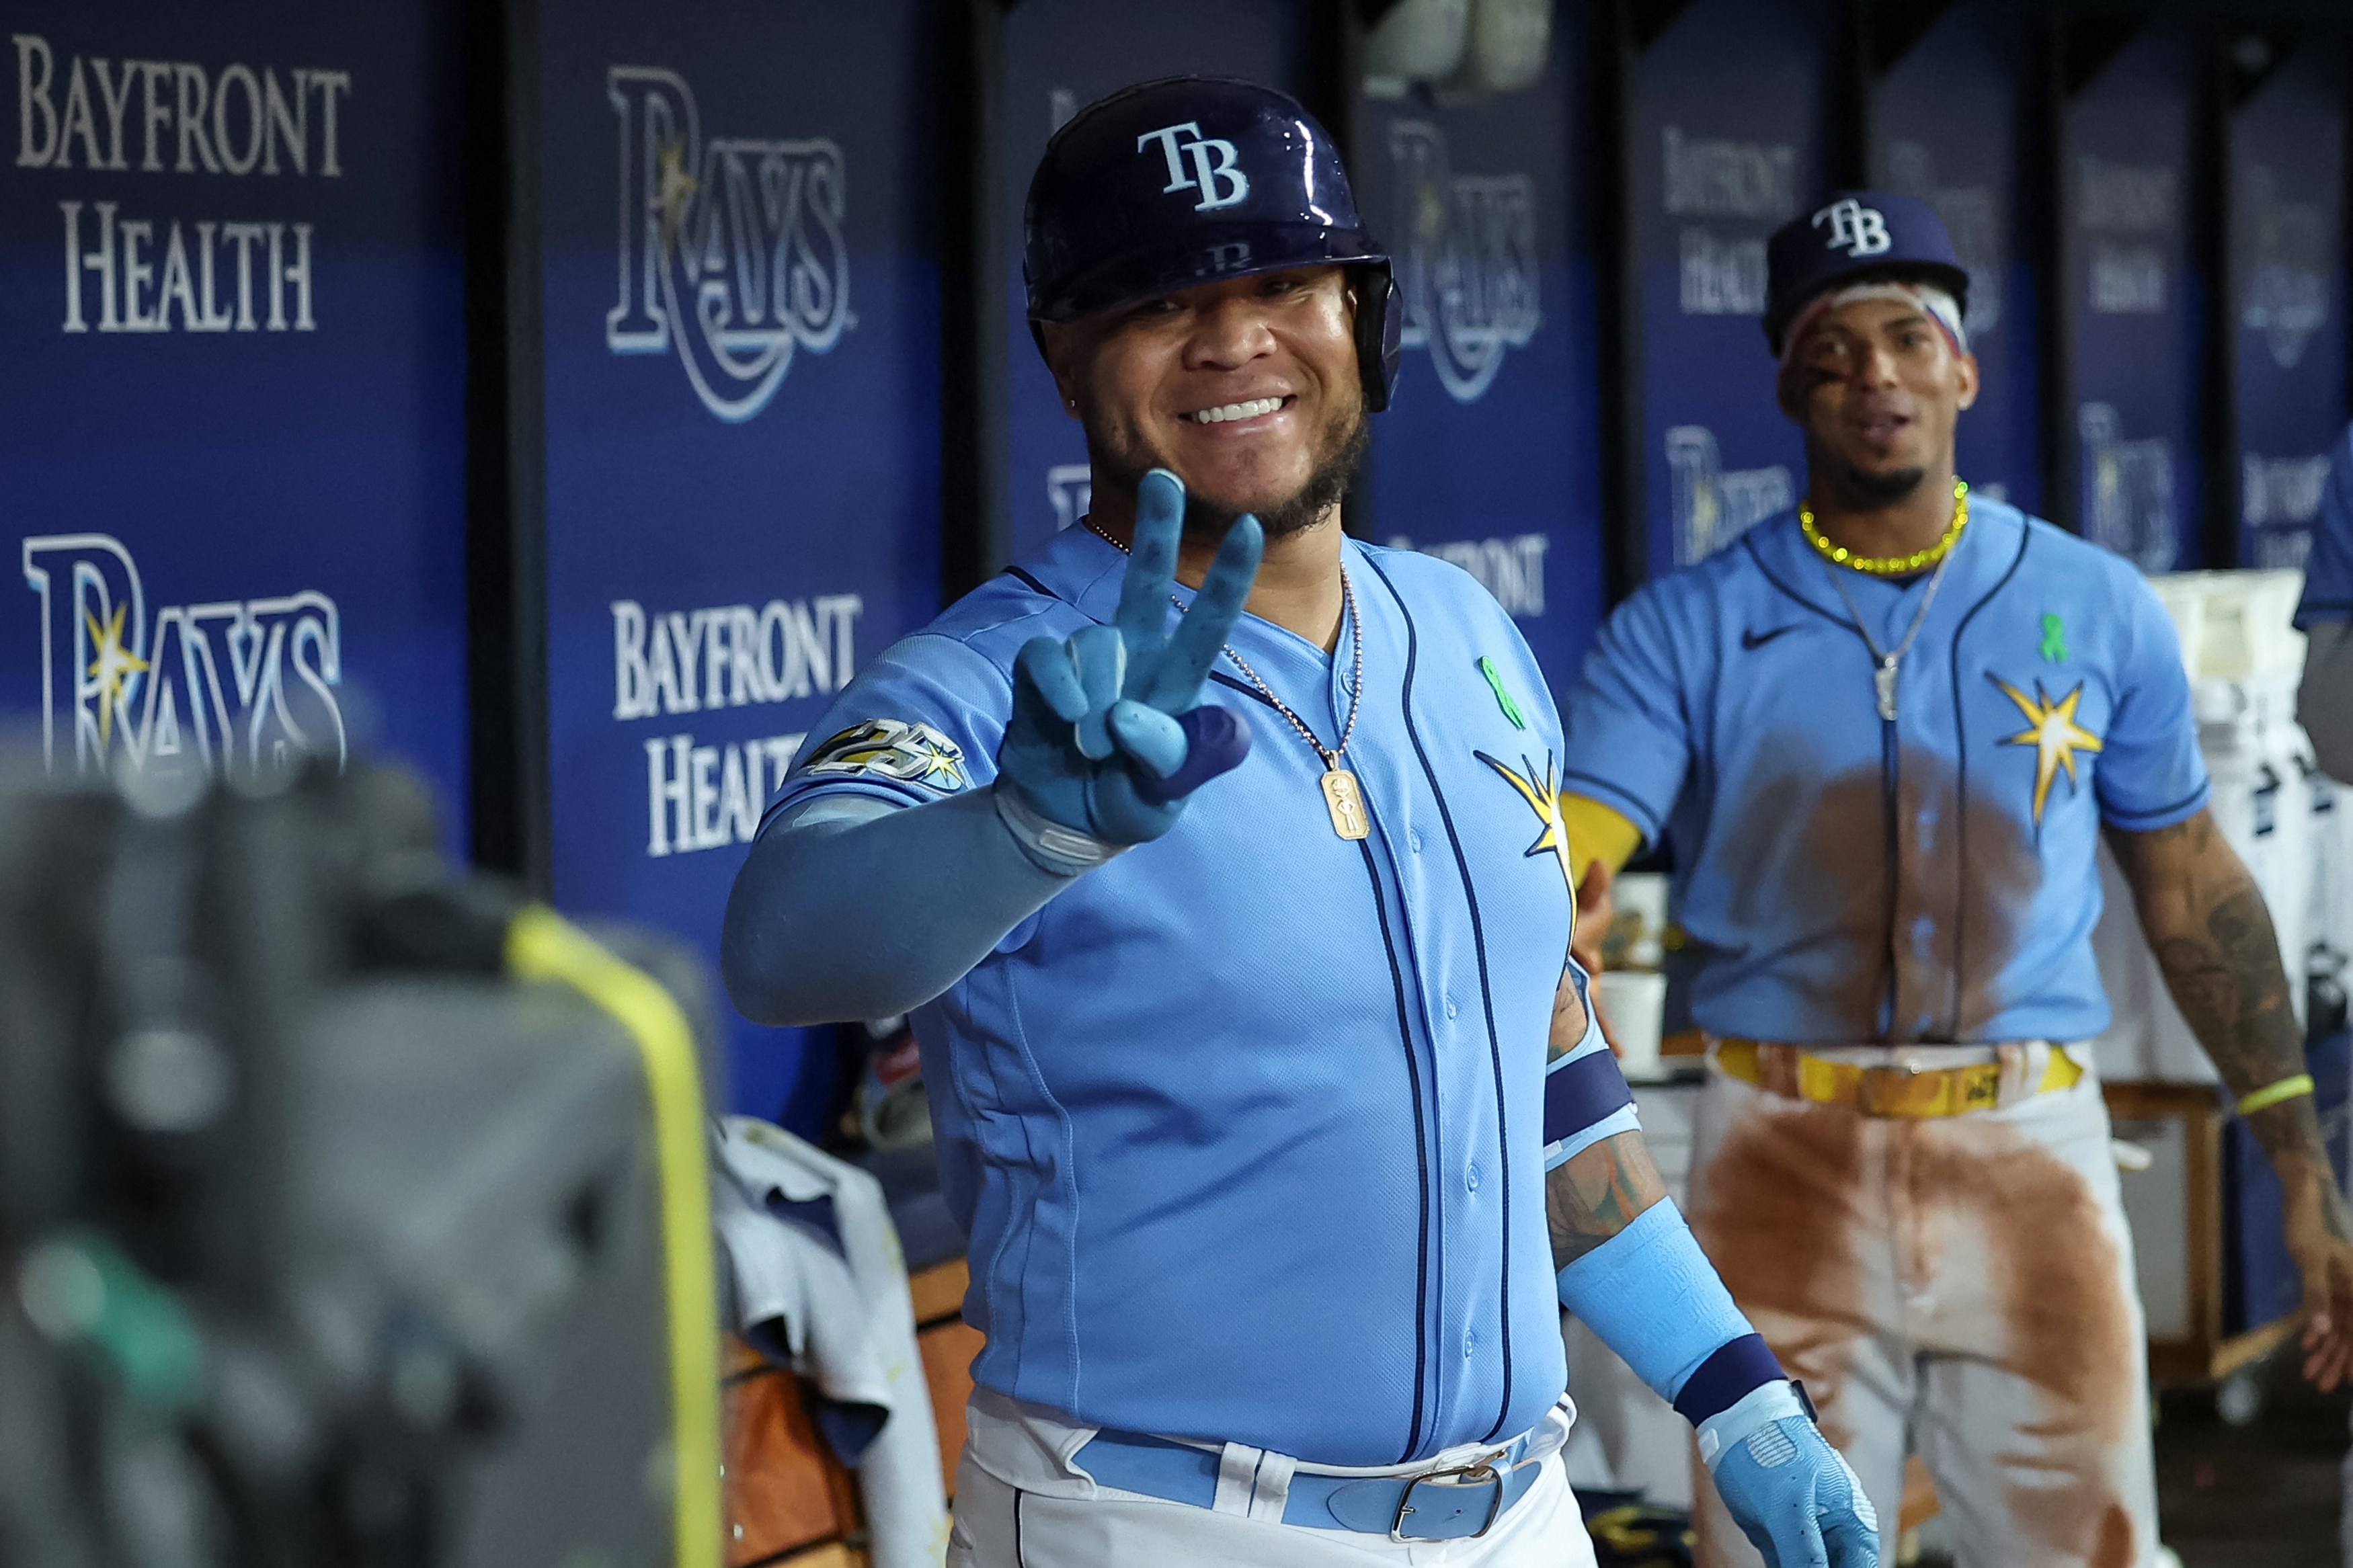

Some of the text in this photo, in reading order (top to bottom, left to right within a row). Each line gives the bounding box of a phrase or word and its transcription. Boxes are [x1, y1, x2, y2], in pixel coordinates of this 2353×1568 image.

[11, 32, 352, 178] BAYFRONT
[1137, 120, 1249, 212] TB
[59, 201, 317, 334] HEALTH
[1811, 198, 1892, 258] TB
[610, 593, 863, 720] BAYFRONT
